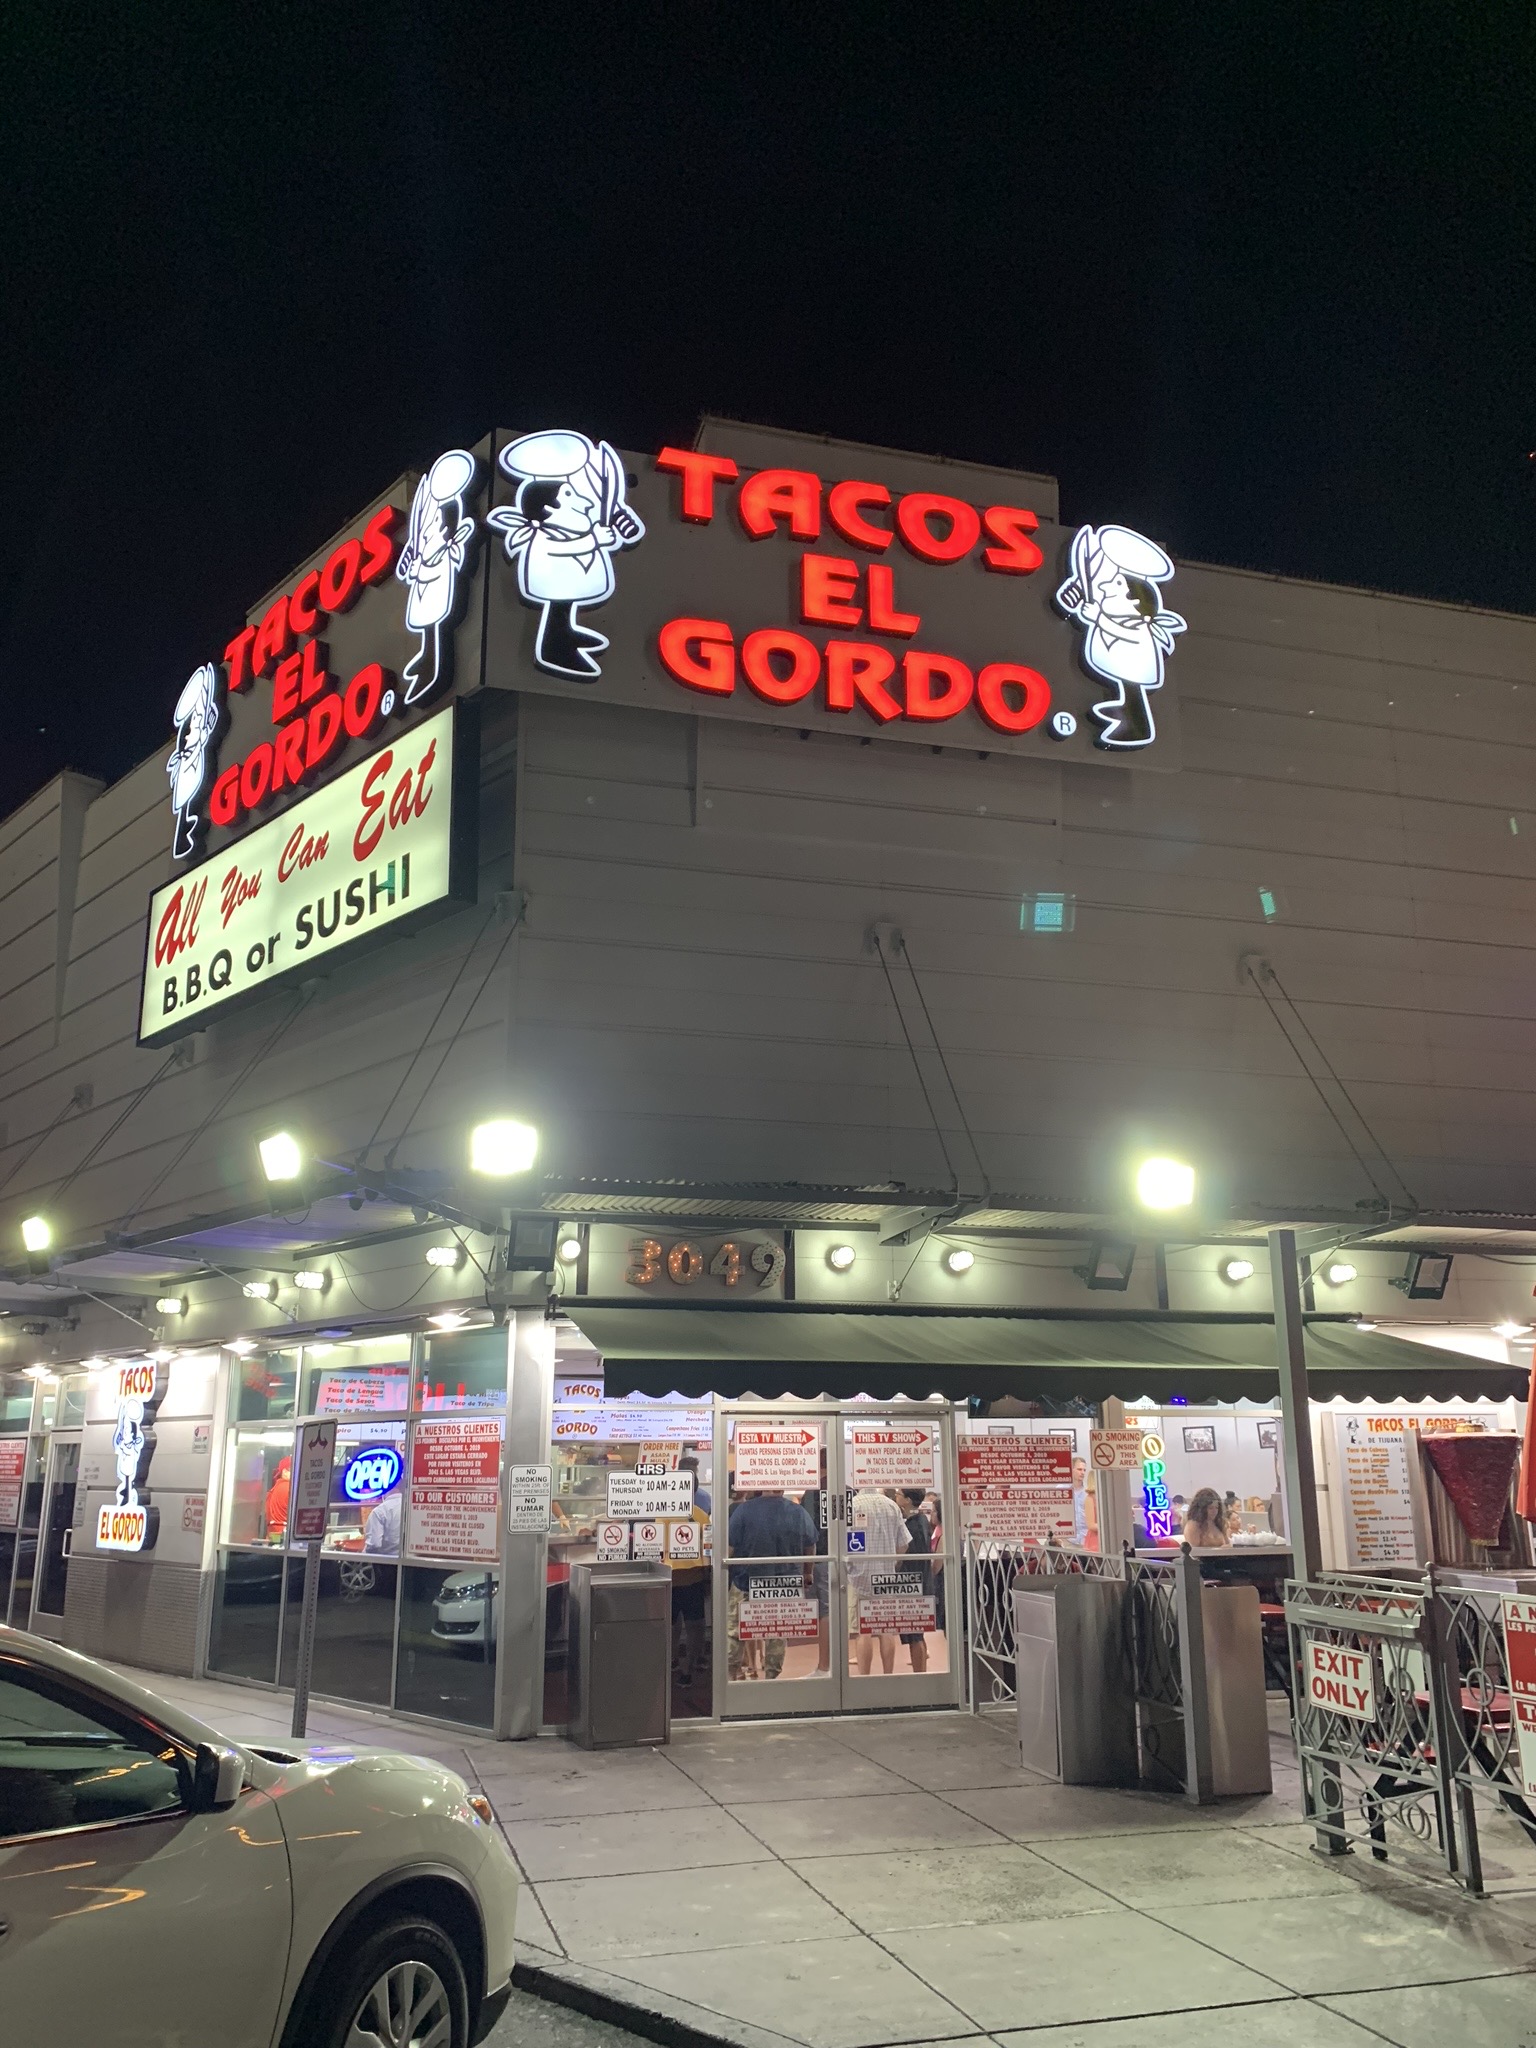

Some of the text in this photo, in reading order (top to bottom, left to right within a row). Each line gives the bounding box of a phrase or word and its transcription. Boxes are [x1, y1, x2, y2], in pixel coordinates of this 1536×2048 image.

[658, 447, 1043, 575] TACOS
[224, 506, 395, 691] TACOS
[802, 554, 920, 638] EL
[271, 639, 326, 724] EL
[659, 618, 1051, 734] GORDO
[209, 662, 384, 825] GORDO
[155, 737, 435, 969] All You Can Eat
[163, 853, 410, 1015] B.B.Q or SUSHI
[625, 1239, 786, 1287] 3049
[119, 1366, 154, 1396] TACOS
[564, 1384, 601, 1399] TACOS
[425, 1425, 461, 1435] NUESTROS
[464, 1424, 498, 1434] CLIENTES
[557, 1422, 598, 1435] GORDO
[1367, 1419, 1403, 1432] TACOS
[741, 1433, 807, 1442] ESTA TV MUESTRA
[857, 1434, 921, 1442] THIS TV SHOWS
[1092, 1432, 1140, 1441] NO SMOKING
[643, 1443, 663, 1451] ORDER
[350, 1460, 393, 1489] OPEN
[637, 1465, 664, 1475] HRS
[647, 1481, 655, 1491] 10
[680, 1480, 690, 1490] AM
[1142, 1433, 1172, 1536] OPEN
[415, 1492, 494, 1503] TO OUR CUSTOMERS
[965, 1491, 1069, 1499] TO OUR CUSTOMERS
[646, 1503, 654, 1512] 10
[679, 1502, 690, 1511] AM
[101, 1512, 144, 1543] EL GORDO
[751, 1578, 802, 1587] ENTRANCE
[872, 1574, 920, 1584] ENTRANCE
[753, 1589, 800, 1598] ENTRADA
[874, 1585, 919, 1594] ENTRADA
[1511, 1605, 1520, 1618] A
[1507, 1622, 1522, 1631] LES
[1313, 1647, 1363, 1680] EXIT
[1312, 1676, 1369, 1712] ONLY
